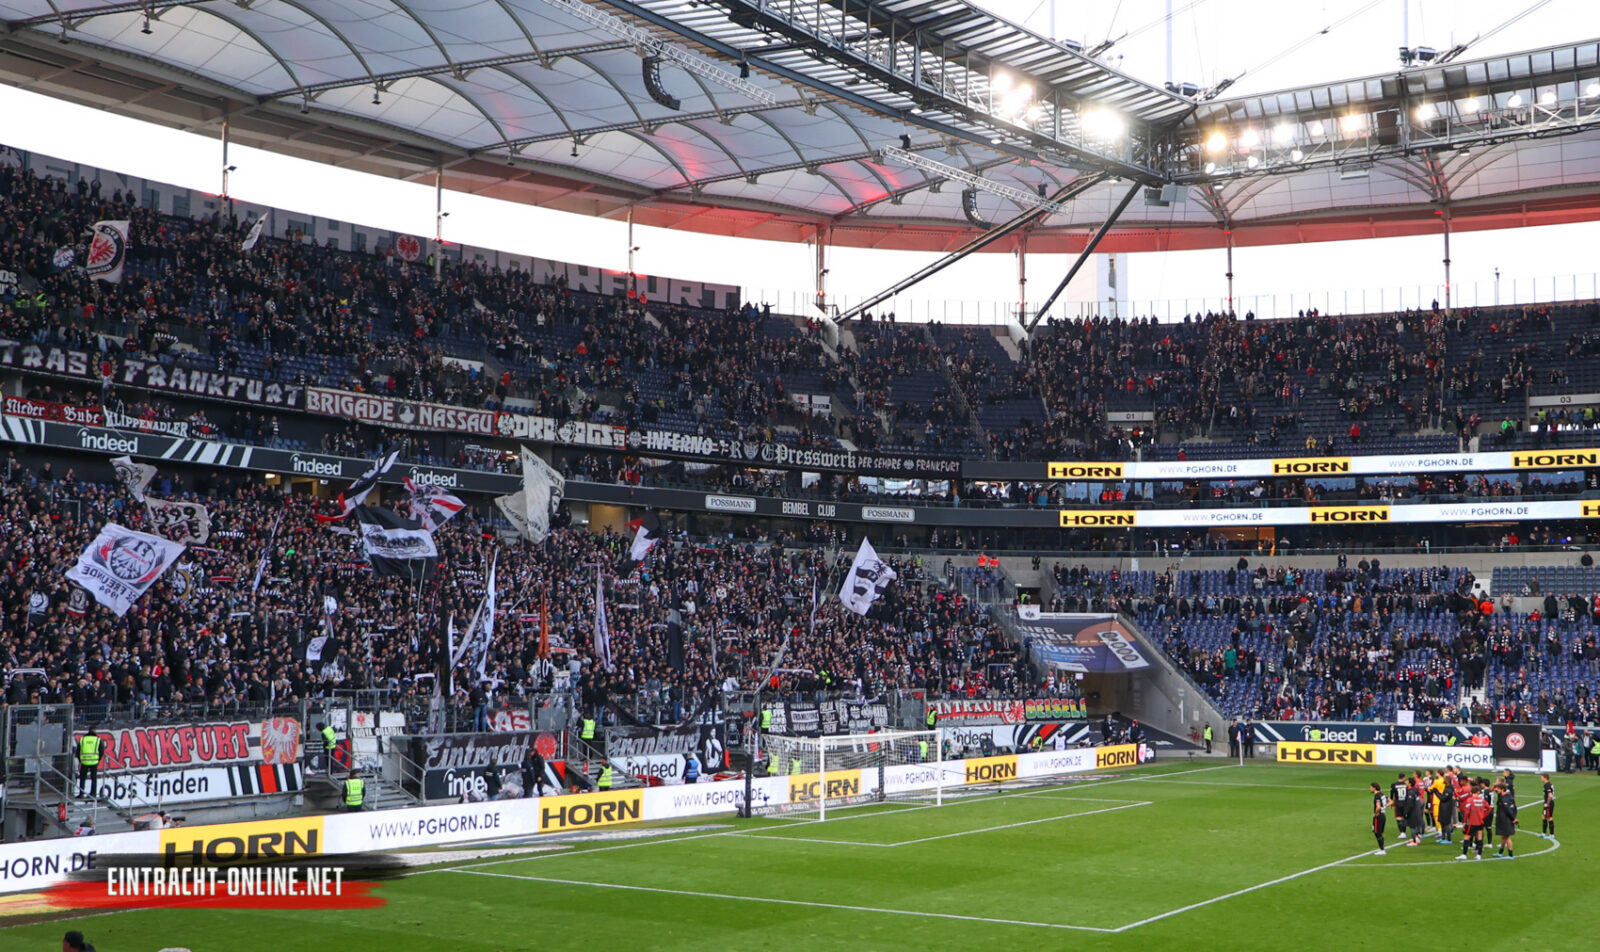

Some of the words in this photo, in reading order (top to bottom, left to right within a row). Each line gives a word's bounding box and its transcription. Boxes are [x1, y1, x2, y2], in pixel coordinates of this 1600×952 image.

[124, 359, 303, 407] FRANKFURT
[1560, 396, 1572, 404] 03
[307, 388, 396, 422] BRIGADE
[418, 404, 496, 434] NASSAU
[105, 410, 188, 438] KLIPPENADLER
[77, 427, 139, 454] indeed
[647, 430, 713, 455] INFERNO
[290, 453, 343, 476] indeed
[858, 456, 873, 468] PER
[916, 459, 960, 473] FRANKFURT
[1388, 458, 1474, 468] WWW.PGHORN.DE
[1513, 453, 1597, 466] HORN
[1050, 466, 1122, 477] HORN
[1159, 464, 1239, 475] WWW.PGHORN.DE
[1274, 462, 1349, 474] HORN
[409, 467, 457, 488] indeed
[710, 497, 752, 509] POSSMANN
[782, 501, 810, 516] BEMBEL
[817, 504, 836, 517] CLUB
[1440, 506, 1529, 516] WWW.PGHORN.DE
[867, 510, 910, 520] POSSMANN
[1063, 514, 1135, 525] HORN
[1183, 512, 1264, 522] WWW.PGHORN.DE
[1311, 510, 1388, 522] HORN
[1301, 725, 1357, 742] ideed
[1405, 730, 1448, 743] finen
[74, 722, 250, 772] RANKFURT
[1280, 747, 1373, 763] HORN
[1096, 750, 1136, 766] HORN
[1408, 751, 1493, 766] WWW.PGHOR
[884, 769, 947, 786] WWW.PGHORN.E
[965, 762, 1017, 782] HORN
[99, 776, 138, 800] obs
[145, 772, 209, 798] finden
[790, 778, 860, 802] HORN
[542, 799, 640, 828] HORN
[369, 812, 501, 839] WWW.PGHORN.DE
[165, 829, 319, 867] HORN
